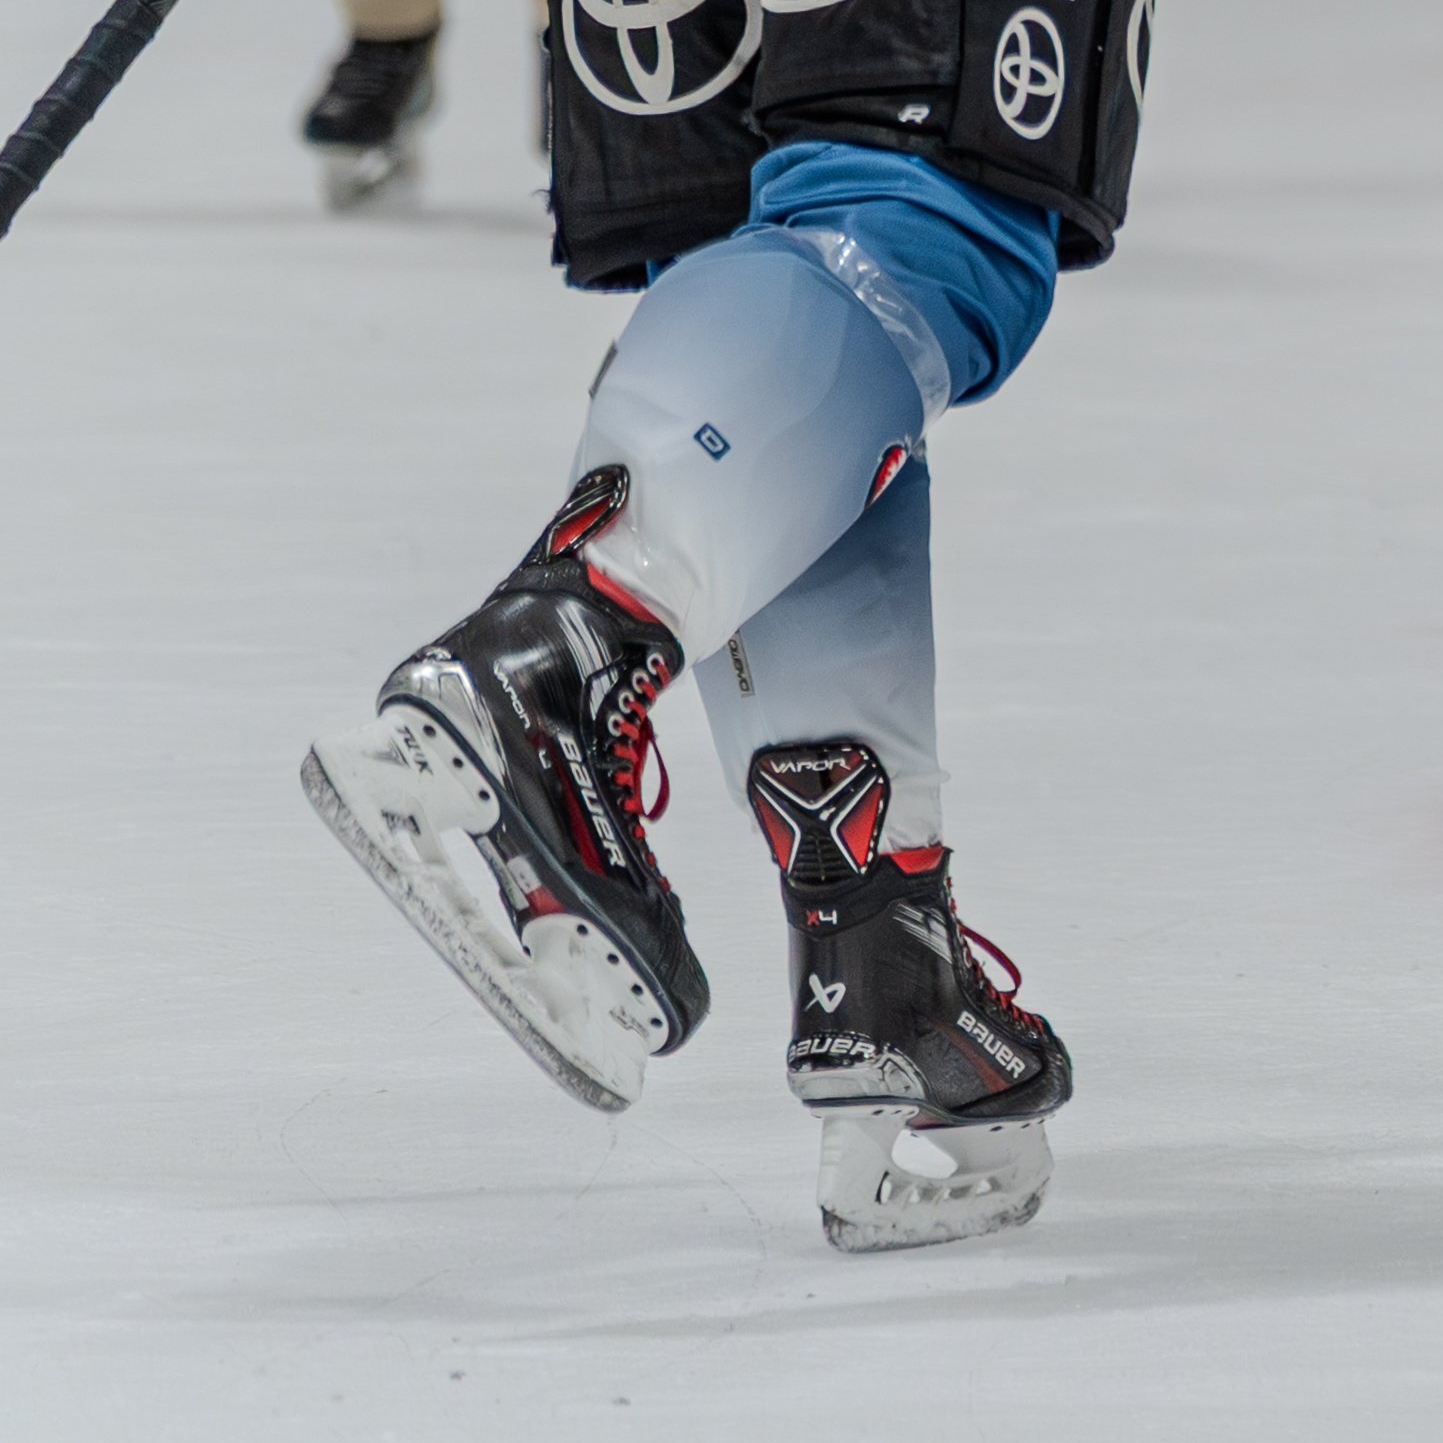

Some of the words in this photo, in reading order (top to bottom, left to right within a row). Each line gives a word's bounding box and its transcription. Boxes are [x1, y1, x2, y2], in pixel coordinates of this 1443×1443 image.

[768, 757, 853, 775] VAPOR
[555, 733, 628, 870] BAUER
[806, 908, 838, 926] X4
[955, 1009, 1028, 1080] BAUER
